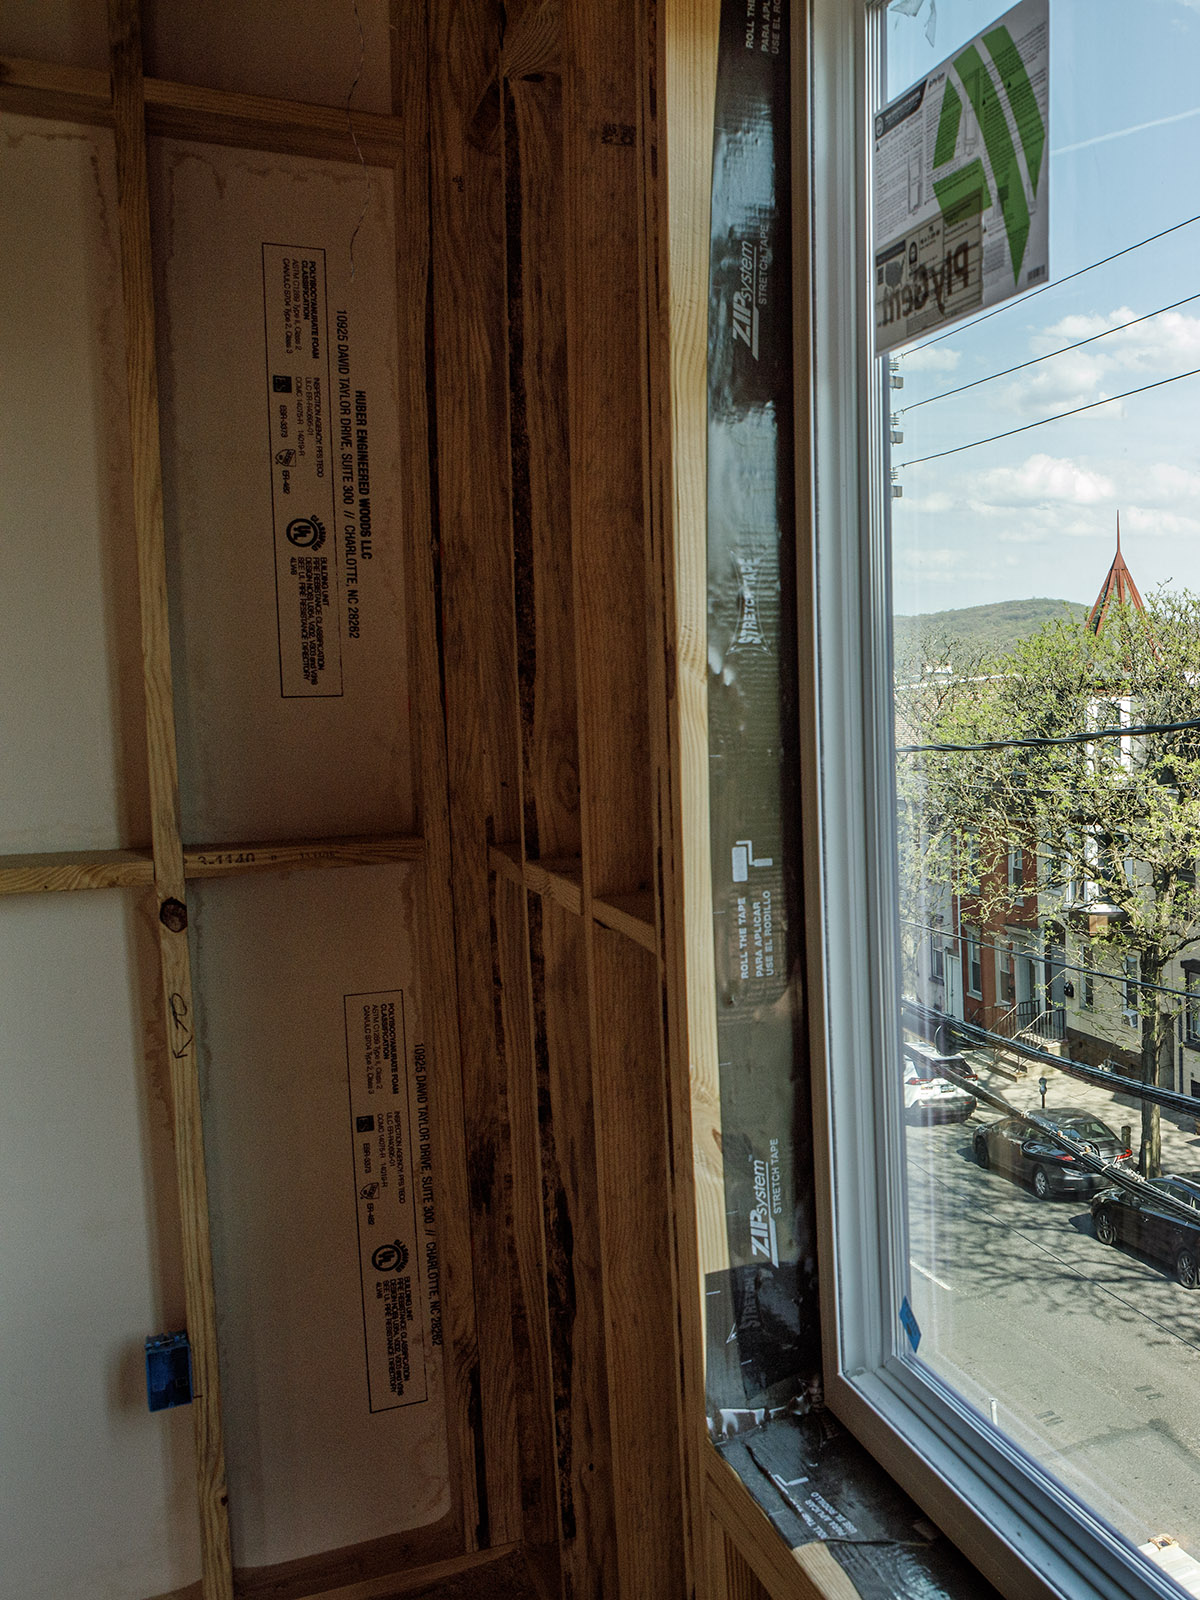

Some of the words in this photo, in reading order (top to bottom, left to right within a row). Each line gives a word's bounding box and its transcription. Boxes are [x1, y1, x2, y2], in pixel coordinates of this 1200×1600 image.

[746, 21, 754, 48] ROLL
[761, 24, 769, 52] PARA
[772, 17, 780, 30] EL
[760, 225, 768, 252] TAPE
[759, 256, 768, 305] STRETCH
[309, 261, 318, 336] POLYISOCYANURATE
[337, 310, 348, 340] 10925
[338, 344, 349, 374] DAVID
[314, 378, 322, 415] INSPECTION
[340, 378, 351, 415] TAYLOR
[356, 390, 367, 426] HUBER
[340, 418, 352, 450] DRIVE,
[342, 454, 353, 482] SUITE
[357, 429, 369, 495] ENGINEERED
[343, 486, 354, 504] 300
[359, 498, 371, 537] WOODS
[345, 525, 357, 586] CHARLOTTE,
[361, 540, 372, 559] LLC
[737, 558, 760, 587] TAPE
[348, 590, 358, 604] NC
[348, 607, 359, 638] 28262
[738, 590, 761, 643] STRETCH
[738, 898, 746, 924] TAPE
[753, 902, 762, 946] APLICAR
[762, 890, 772, 936] RODILLO
[739, 928, 747, 948] THE
[765, 939, 772, 952] EL
[740, 952, 749, 979] ROLL
[755, 950, 763, 977] PARA
[765, 956, 774, 976] USE
[381, 1004, 389, 1059] CLASSIFICATION
[388, 1003, 397, 1073] POLYISOCYANURATE
[414, 1043, 425, 1072] 10925
[416, 1076, 427, 1103] DAVID
[394, 1111, 402, 1146] INSPECTION
[418, 1105, 430, 1141] TAYLOR
[420, 1144, 431, 1175] DRIVE,
[770, 1139, 779, 1165] TAPE
[422, 1177, 433, 1203] SUITE
[772, 1167, 782, 1214] STRETCH
[424, 1206, 434, 1223] 300
[426, 1242, 439, 1300] CHARLOTTE,
[430, 1301, 440, 1314] NC
[431, 1317, 442, 1346] 28262
